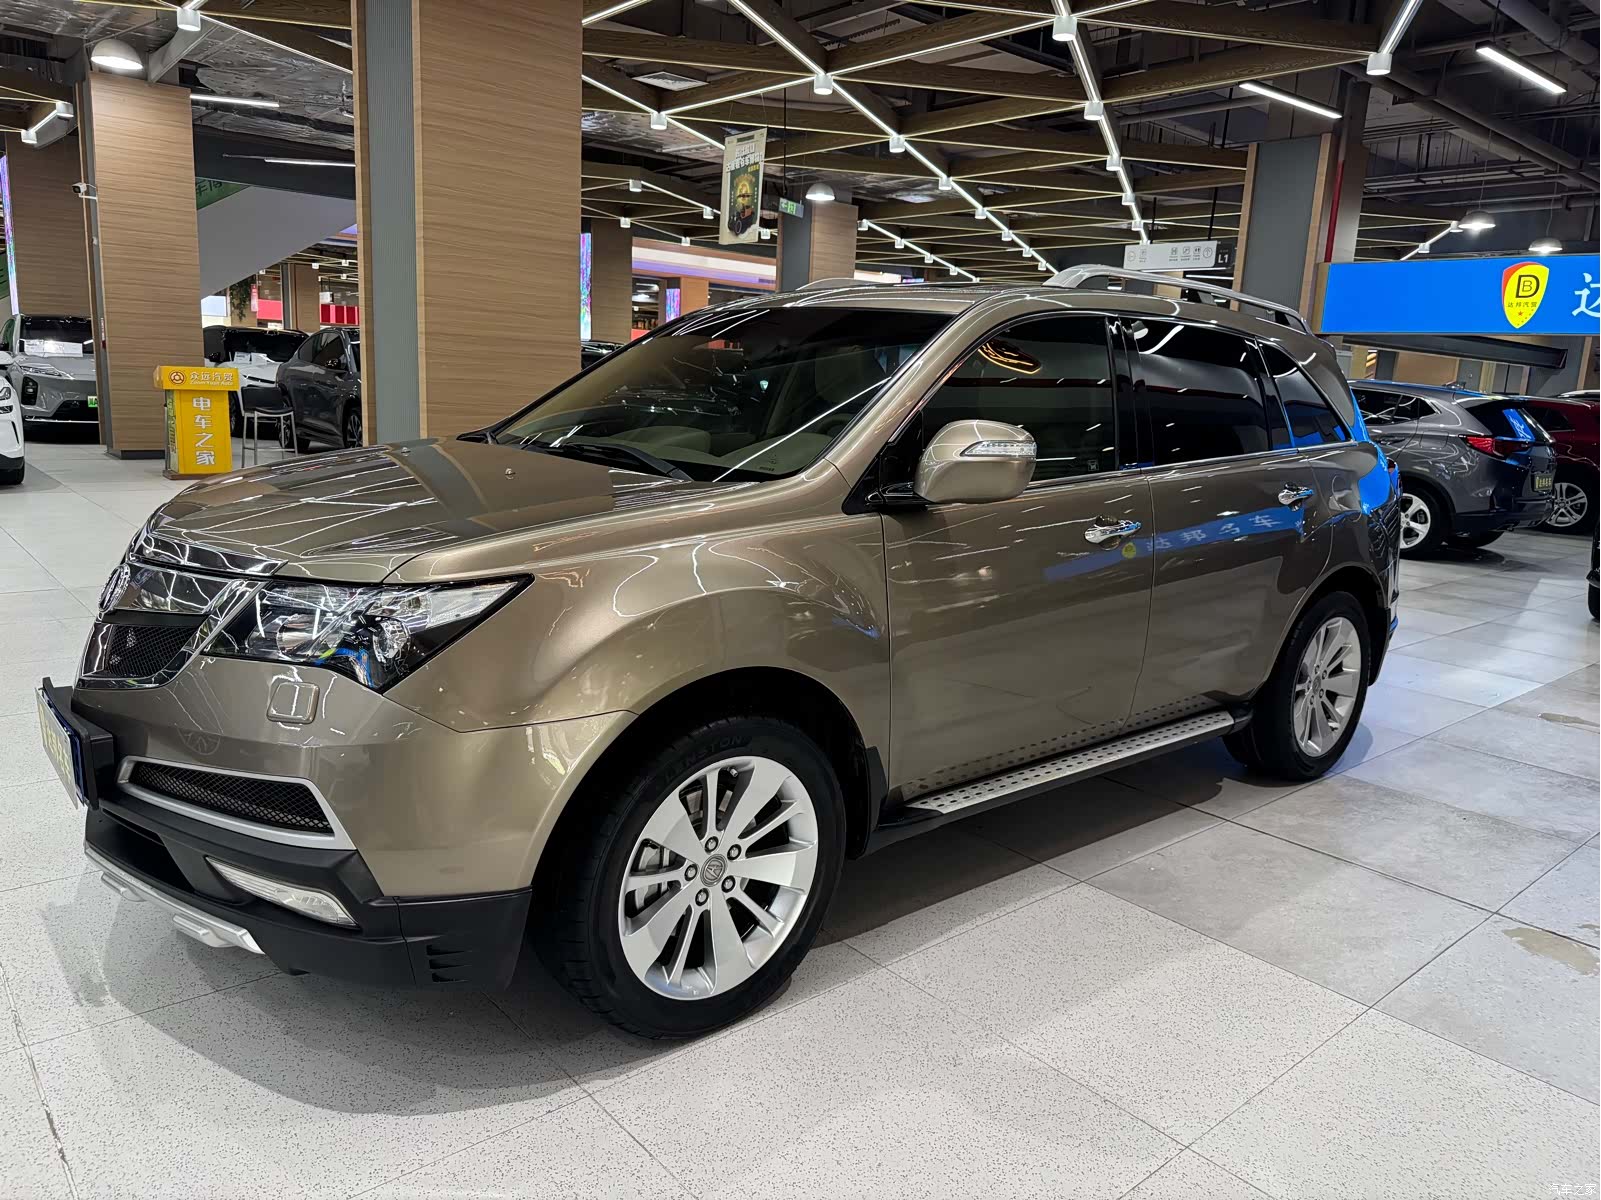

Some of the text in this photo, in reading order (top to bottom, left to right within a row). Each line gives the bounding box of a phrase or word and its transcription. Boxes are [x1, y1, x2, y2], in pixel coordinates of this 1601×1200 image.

[1218, 254, 1229, 263] L1
[190, 371, 233, 381] 众远汽贸
[192, 396, 215, 465] 电车之家
